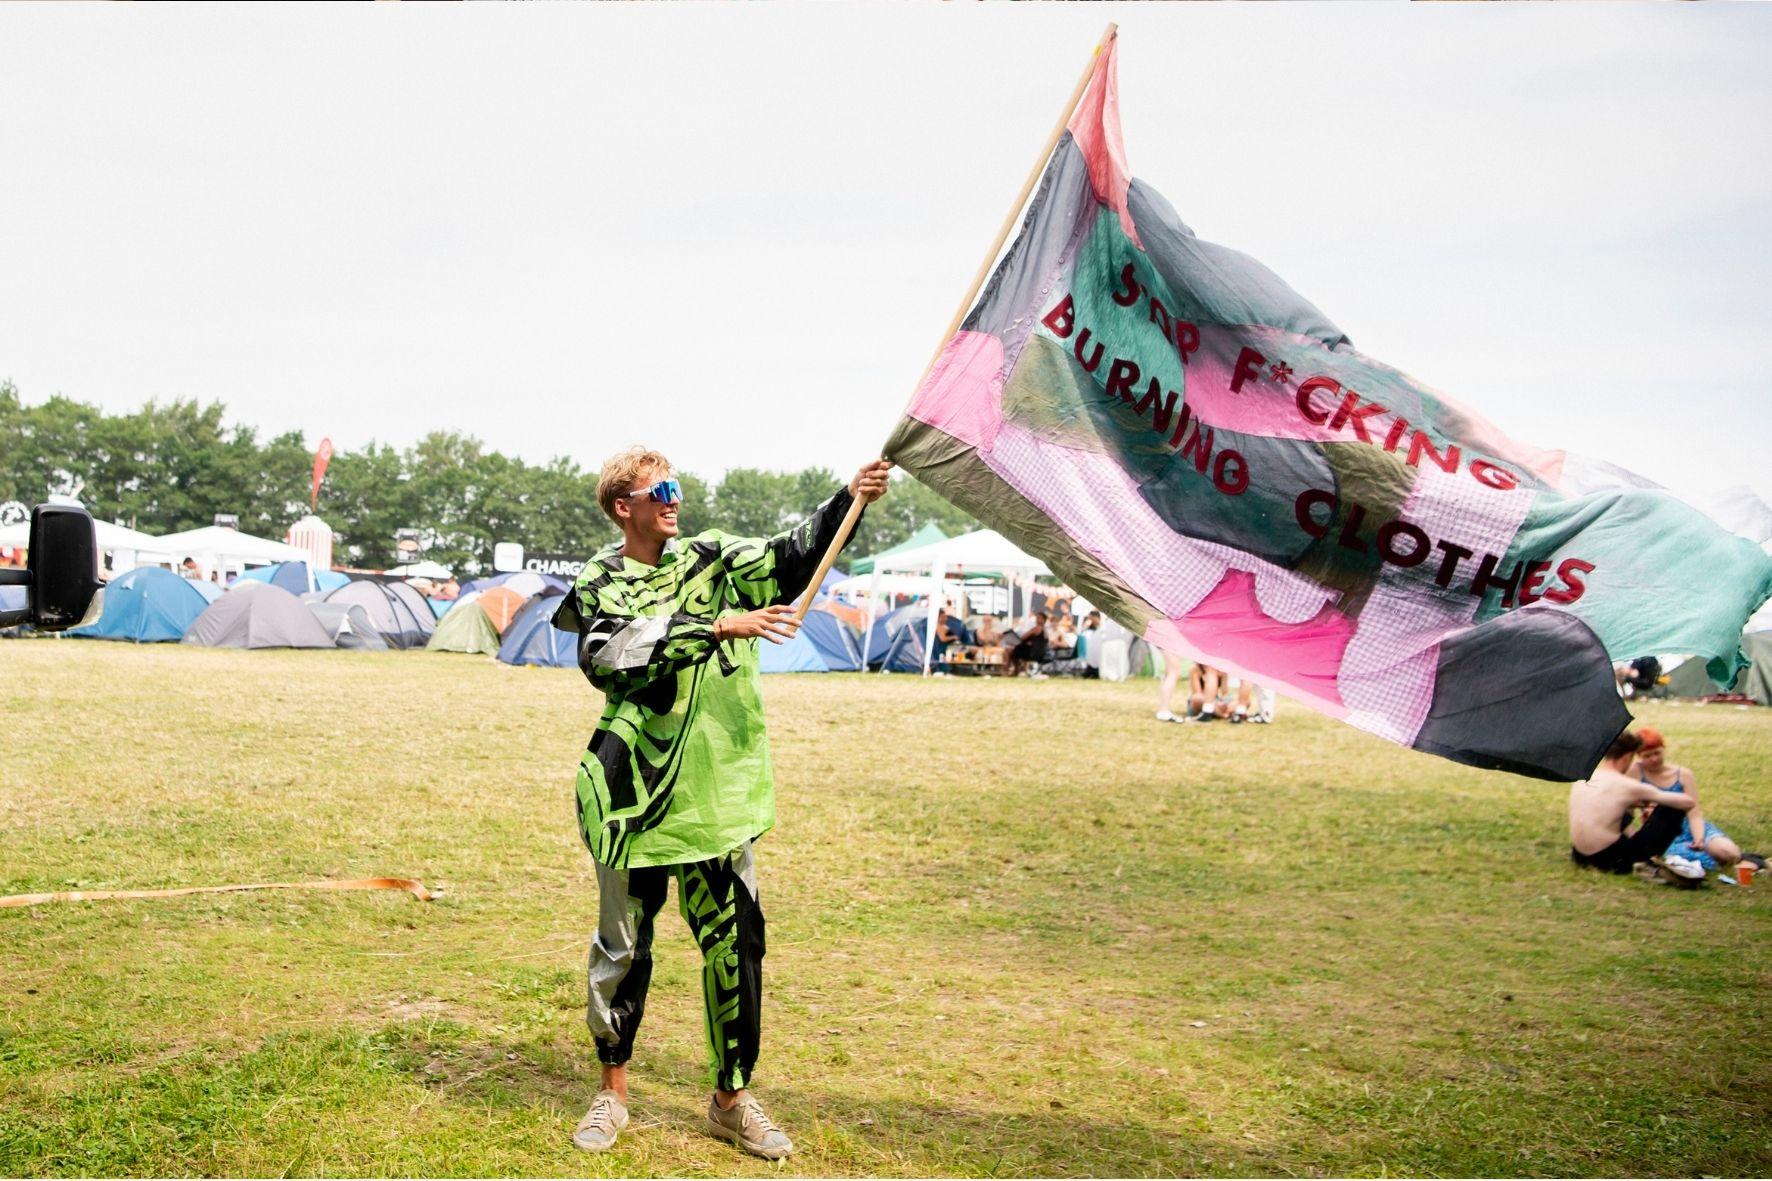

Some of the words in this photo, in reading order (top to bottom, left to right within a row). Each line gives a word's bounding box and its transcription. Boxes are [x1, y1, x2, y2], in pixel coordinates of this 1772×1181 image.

[1111, 262, 1200, 365] SOP
[1041, 293, 1249, 496] BURNING
[1295, 488, 1596, 608] CLOTHES
[526, 558, 585, 576] CHARG
